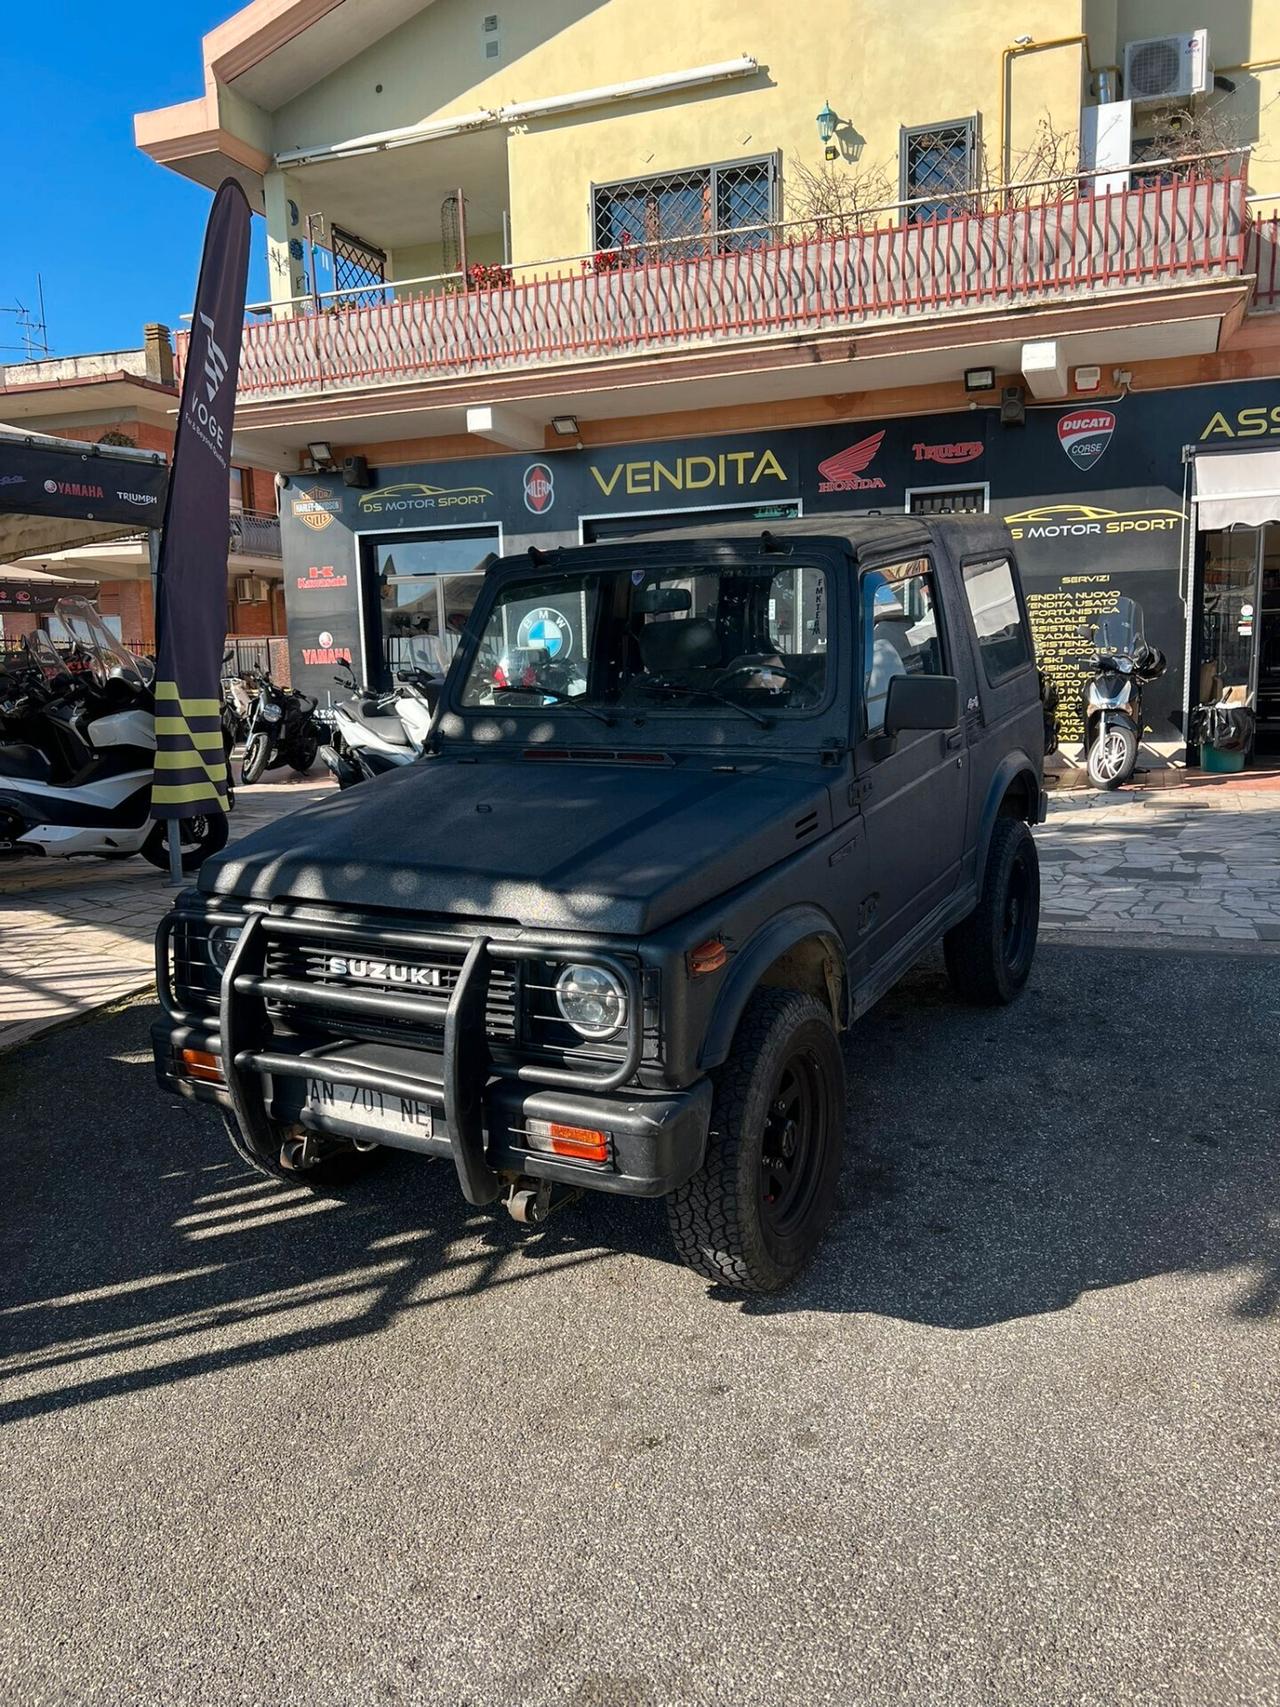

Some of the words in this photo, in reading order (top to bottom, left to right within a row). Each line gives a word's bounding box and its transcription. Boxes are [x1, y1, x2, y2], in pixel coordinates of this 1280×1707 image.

[191, 391, 224, 449] VOGE
[1062, 416, 1111, 432] DUCATI
[1071, 442, 1103, 455] CORSE
[589, 449, 788, 496] VENDITA
[57, 483, 104, 498] YAMAHA
[818, 477, 886, 493] HONDA
[116, 491, 158, 505] TRIUMPH
[364, 503, 383, 513] DS
[385, 499, 436, 511] MOTOR
[438, 494, 487, 507] SPORT
[1011, 527, 1023, 540] S
[1027, 522, 1102, 539] MOTOR
[1105, 517, 1178, 534] SPORT
[1061, 574, 1110, 585] SERVIZI
[1075, 590, 1121, 599] NUOVO
[1075, 598, 1118, 608] USATO
[302, 647, 353, 666] YAMAHA
[329, 956, 441, 986] SUZUKI
[310, 1079, 335, 1106] AN
[400, 1098, 429, 1127] NE
